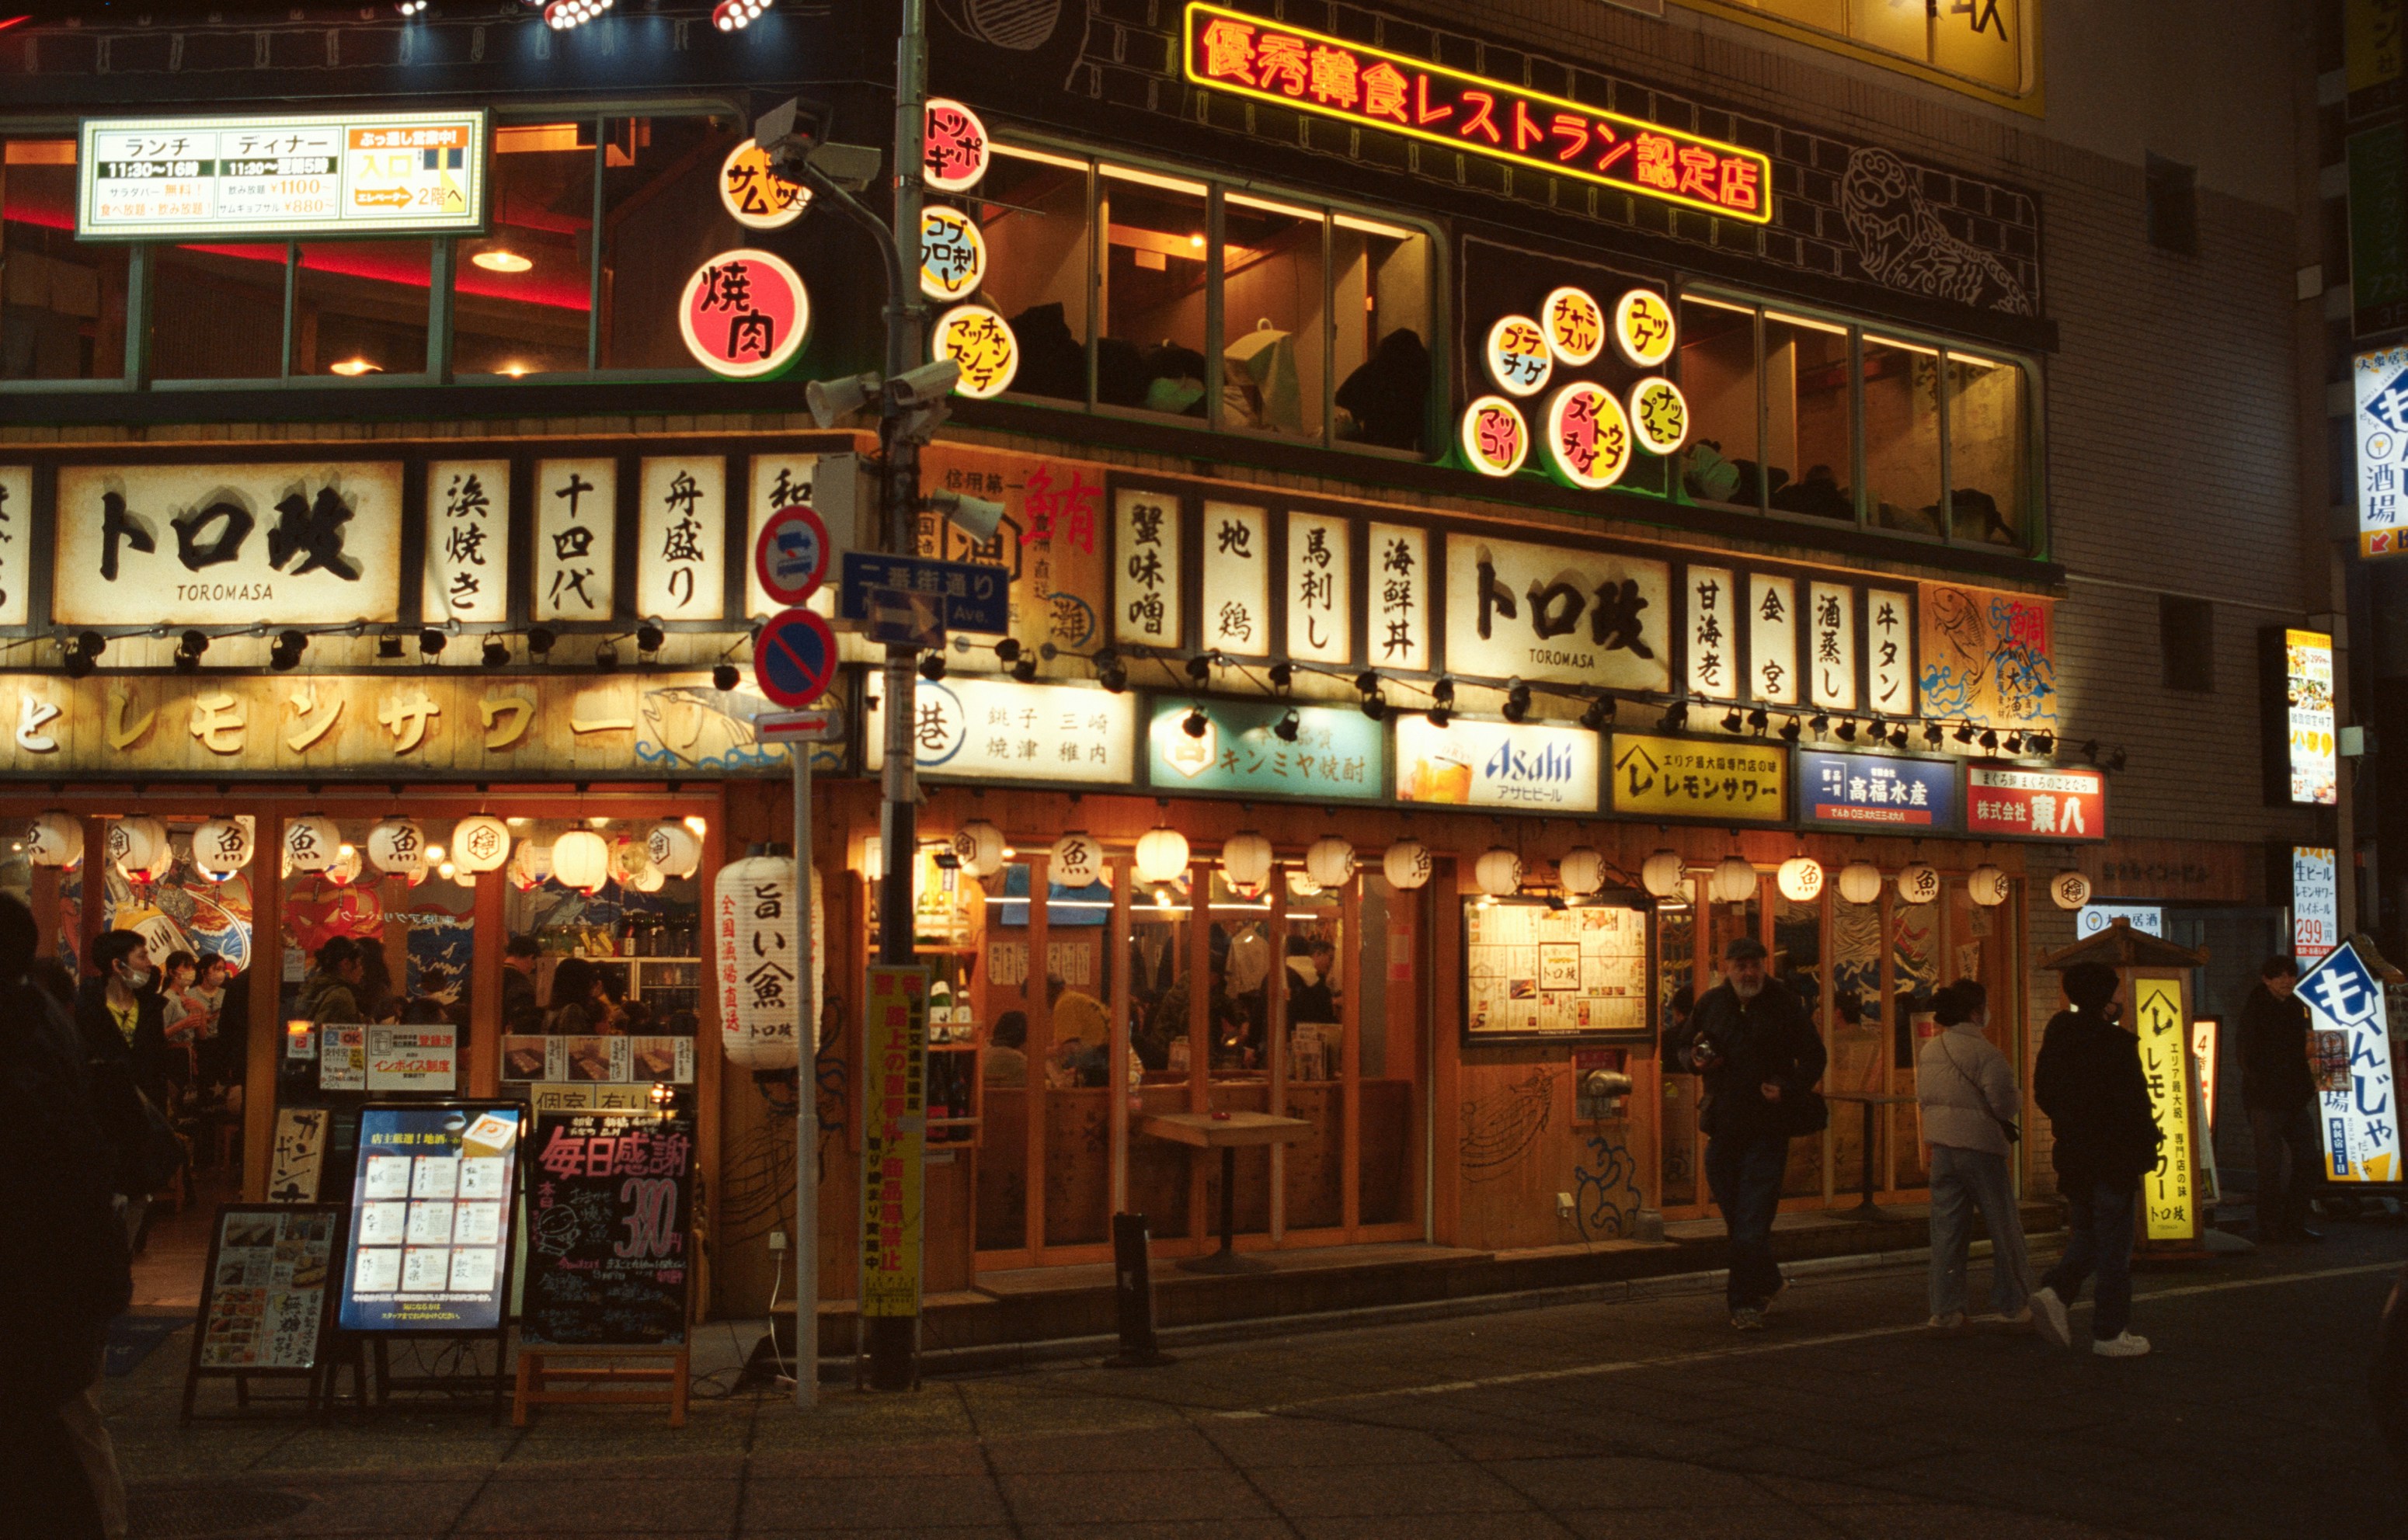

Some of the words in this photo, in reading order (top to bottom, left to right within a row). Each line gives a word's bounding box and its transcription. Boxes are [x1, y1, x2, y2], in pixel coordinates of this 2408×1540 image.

[1204, 19, 1759, 209] 優秀韓食レストラン認定店
[126, 137, 190, 157] ランチ
[239, 134, 328, 155] ディナー
[925, 108, 983, 178] トッポギ
[360, 155, 413, 180] 入口
[110, 189, 160, 197] サラダバー
[228, 184, 265, 195] 飲み放題
[418, 187, 462, 206] 2階へ
[701, 261, 774, 360] 焼肉
[1554, 298, 1596, 351] チャミスル
[1631, 298, 1669, 353] ユッケ
[1478, 408, 1515, 471] マッコリ
[945, 469, 1025, 493] 信用第一
[2367, 463, 2396, 523] 酒場
[445, 473, 490, 609] 浜焼き
[549, 473, 594, 609] 十四代
[662, 469, 705, 608] 舟盛り
[860, 564, 993, 599] 一番街通り
[1129, 503, 1165, 635] 蟹味噌
[1217, 520, 1252, 643] 地鶏
[177, 583, 273, 601] TOROMASA
[1300, 527, 1332, 650] 馬刺し
[1383, 539, 1415, 661] 海鮮丼
[1696, 579, 1723, 688] 甘海老
[1759, 587, 1786, 695] 金宮
[1817, 594, 1841, 698] 酒蒸し
[1529, 648, 1595, 669] TOROMASA
[1876, 602, 1899, 703] 牛タン
[988, 706, 1038, 729] 銚子
[1060, 712, 1108, 735] 三崎
[987, 736, 1039, 760] 焼津
[1059, 742, 1107, 764] 稚内
[1220, 748, 1366, 783] キンミヤ焼酎
[1486, 738, 1571, 783] Asahi
[1498, 785, 1563, 803] アサヒビール
[1665, 773, 1777, 801] レモンサワー
[1849, 776, 1928, 806] 高福水産
[1978, 800, 2026, 822] 株式会社
[215, 826, 243, 861] 魚
[289, 825, 320, 860] 魚
[389, 826, 419, 861] 魚
[1061, 841, 1089, 875] 魚
[1800, 864, 1818, 892] 魚
[1916, 869, 1936, 895] 魚
[2295, 860, 2333, 881] 生ビール
[2295, 886, 2333, 899] レモンサワー
[2298, 902, 2332, 915] ハイボール
[2295, 918, 2323, 944] 299
[343, 1034, 360, 1044] OK
[375, 1060, 451, 1072] インボイス制度
[538, 1125, 691, 1180] 毎日感謝
